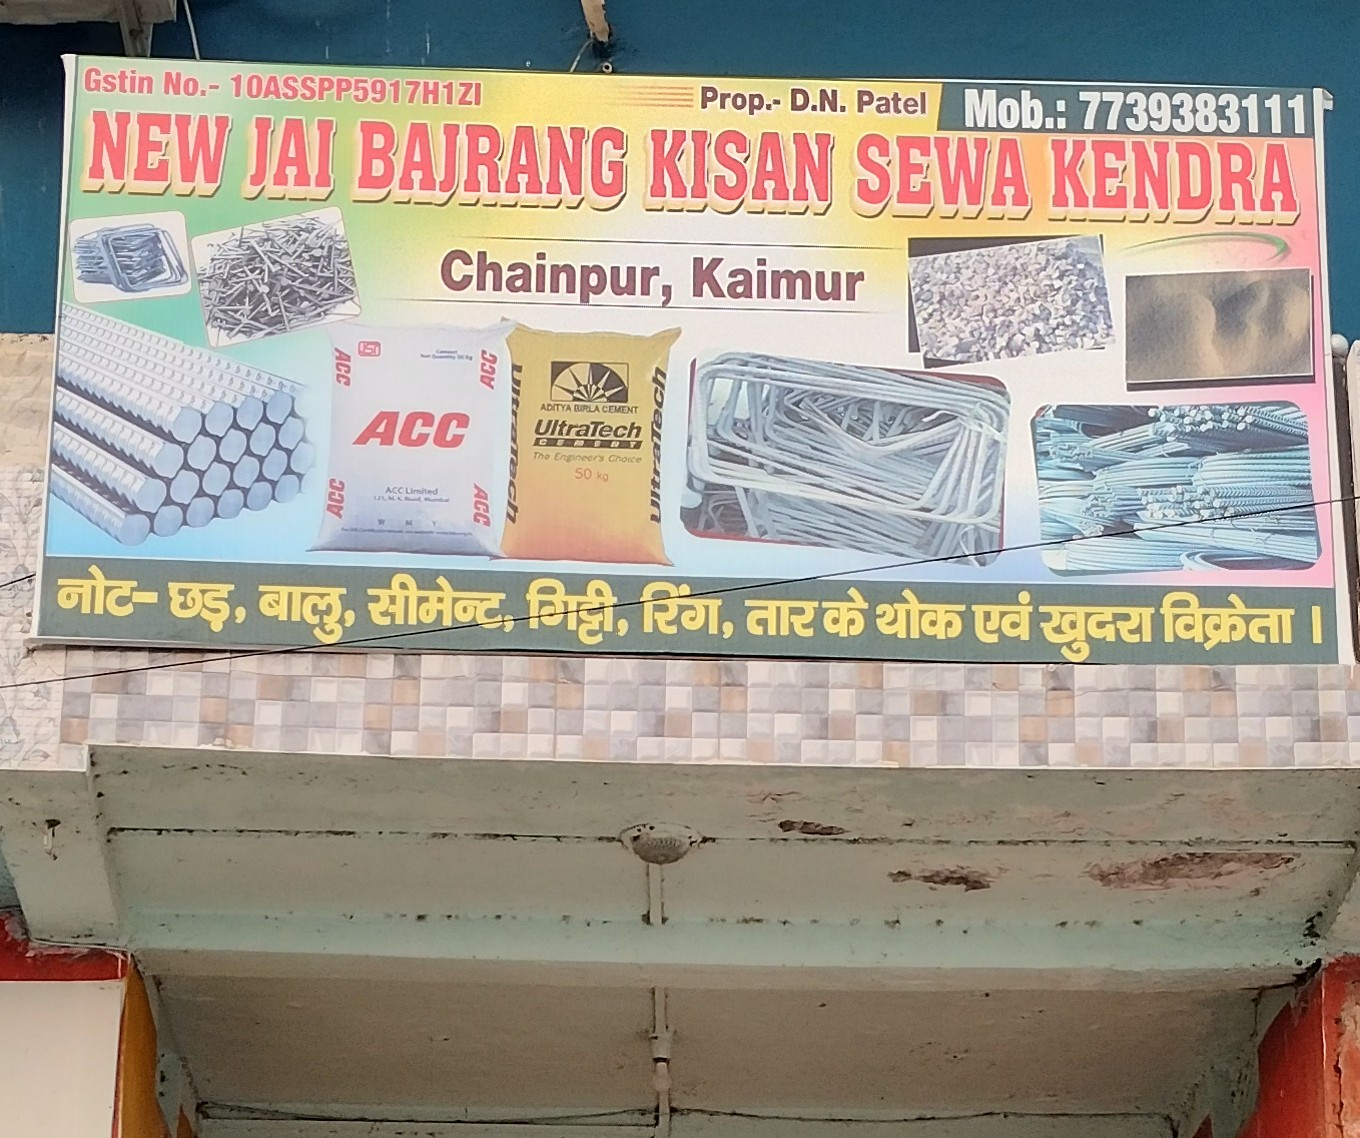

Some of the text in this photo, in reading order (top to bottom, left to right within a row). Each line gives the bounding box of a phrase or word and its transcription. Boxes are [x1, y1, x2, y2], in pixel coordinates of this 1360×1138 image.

[83, 68, 158, 97] Gstin
[163, 71, 220, 98] No.-
[700, 86, 927, 115] Prop.- D.N. Patel
[964, 88, 1307, 135] Mob.: 7739383111
[83, 110, 1301, 224] NEW JAI BAJRANG KISAN SEWA KENDRA
[440, 248, 865, 307] Chainpur, Kaimur
[334, 347, 352, 387] ACC
[479, 349, 498, 390] ACC
[534, 418, 643, 439] UltraTech
[540, 403, 639, 414] ADITYA BIRLA CEMENT
[352, 410, 471, 449] ACC
[507, 362, 523, 524] UltraTech
[649, 365, 668, 524] UltraTech
[574, 467, 593, 480] 50
[326, 478, 346, 519] ACC
[473, 483, 491, 526] ACC
[56, 564, 160, 618] नोट-
[168, 579, 248, 633] छड़,
[258, 582, 356, 644] बालु,
[745, 596, 816, 638] तार
[822, 587, 869, 638] के
[875, 589, 966, 641] थोक
[971, 590, 1033, 643] एवं
[1039, 603, 1155, 664] खुदरा
[1160, 590, 1295, 651] विक्रेता
